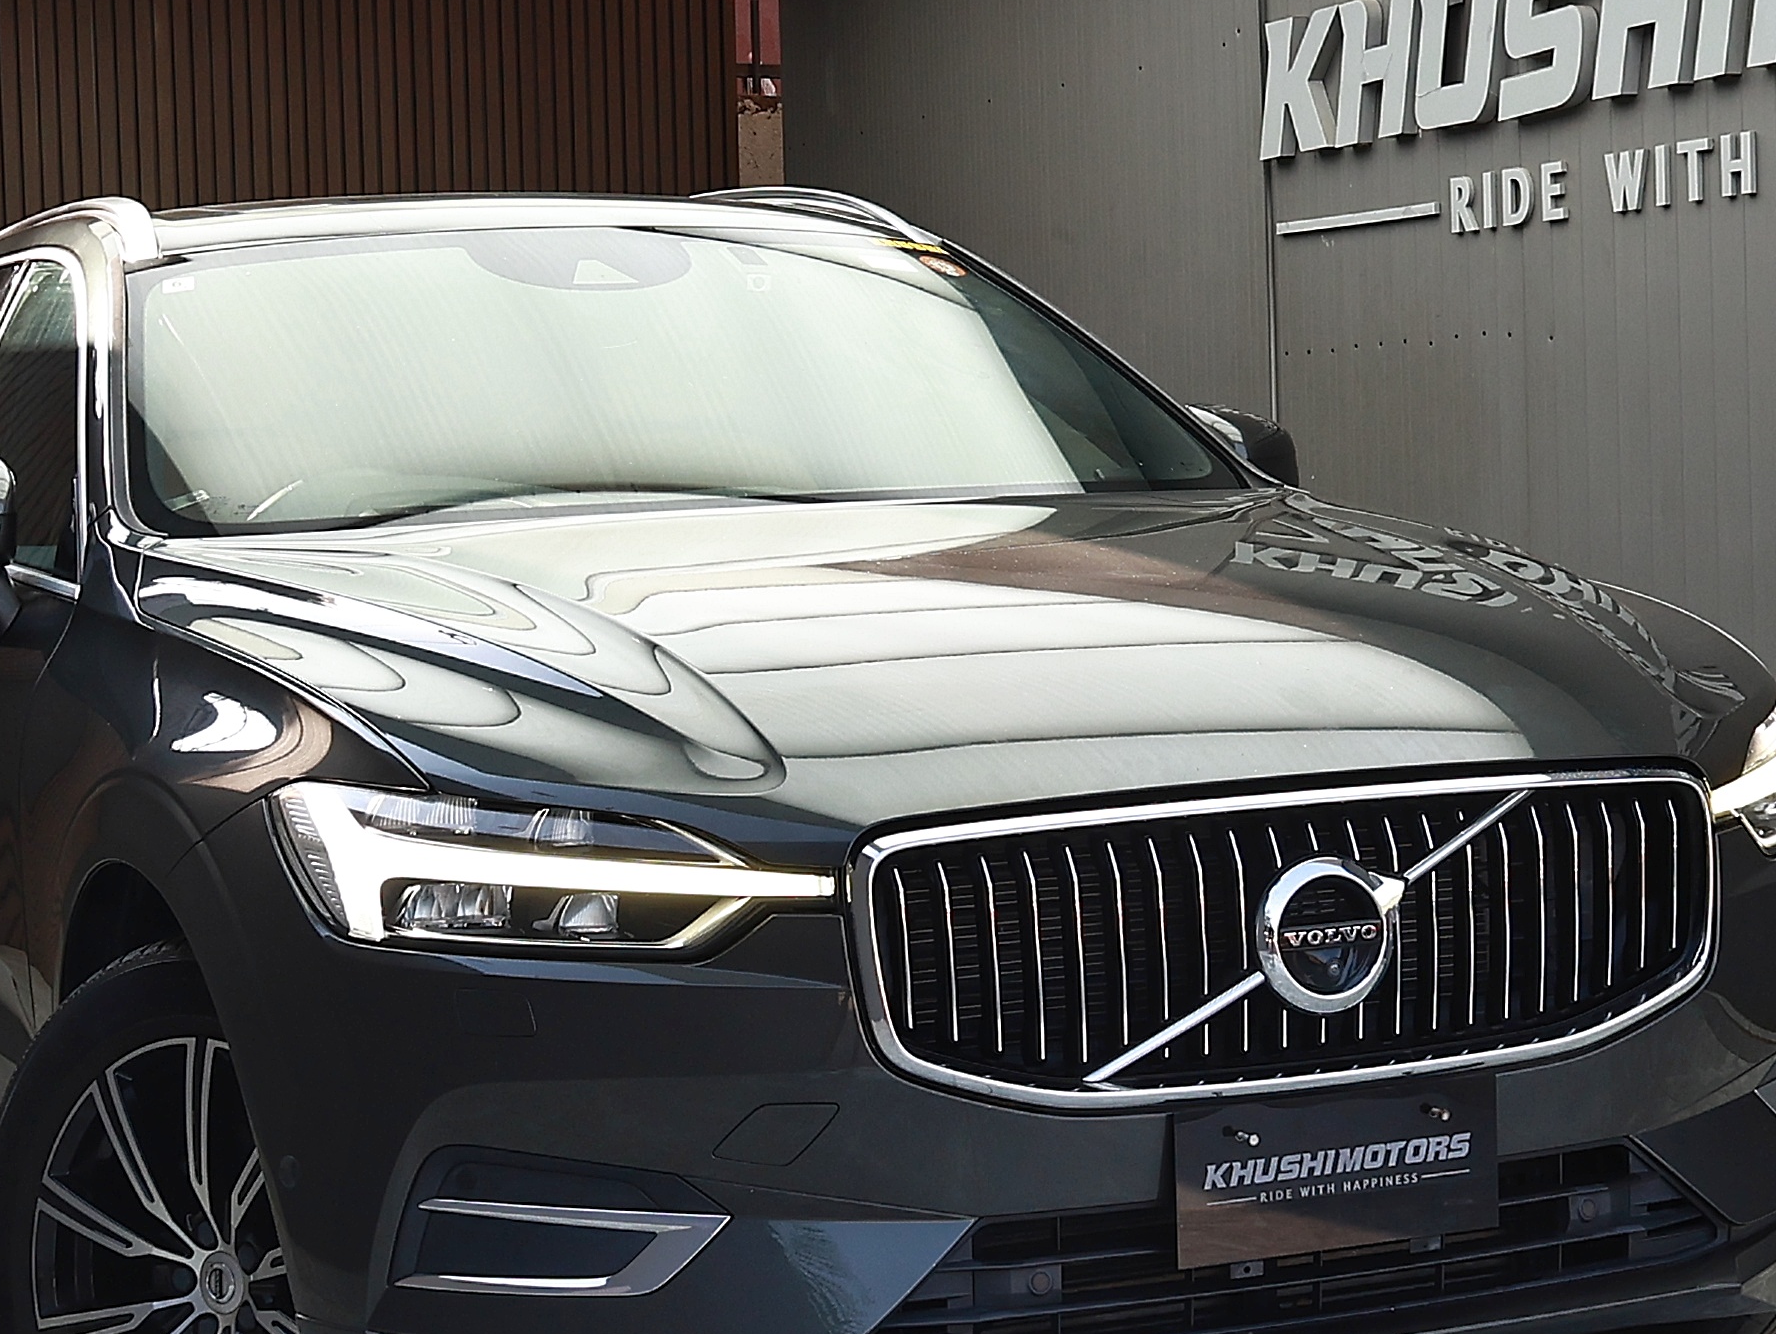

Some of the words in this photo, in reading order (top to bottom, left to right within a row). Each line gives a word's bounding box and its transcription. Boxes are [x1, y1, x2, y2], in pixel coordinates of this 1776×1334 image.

[1450, 160, 1569, 234] RIDE
[1603, 130, 1758, 213] WITH
[1283, 924, 1377, 947] VOLVO
[1203, 1131, 1472, 1191] KHUSHIMOTORS
[1259, 1188, 1293, 1203] RIDE
[1299, 1182, 1336, 1198] WITH
[1343, 1172, 1419, 1192] HAPPINESS
